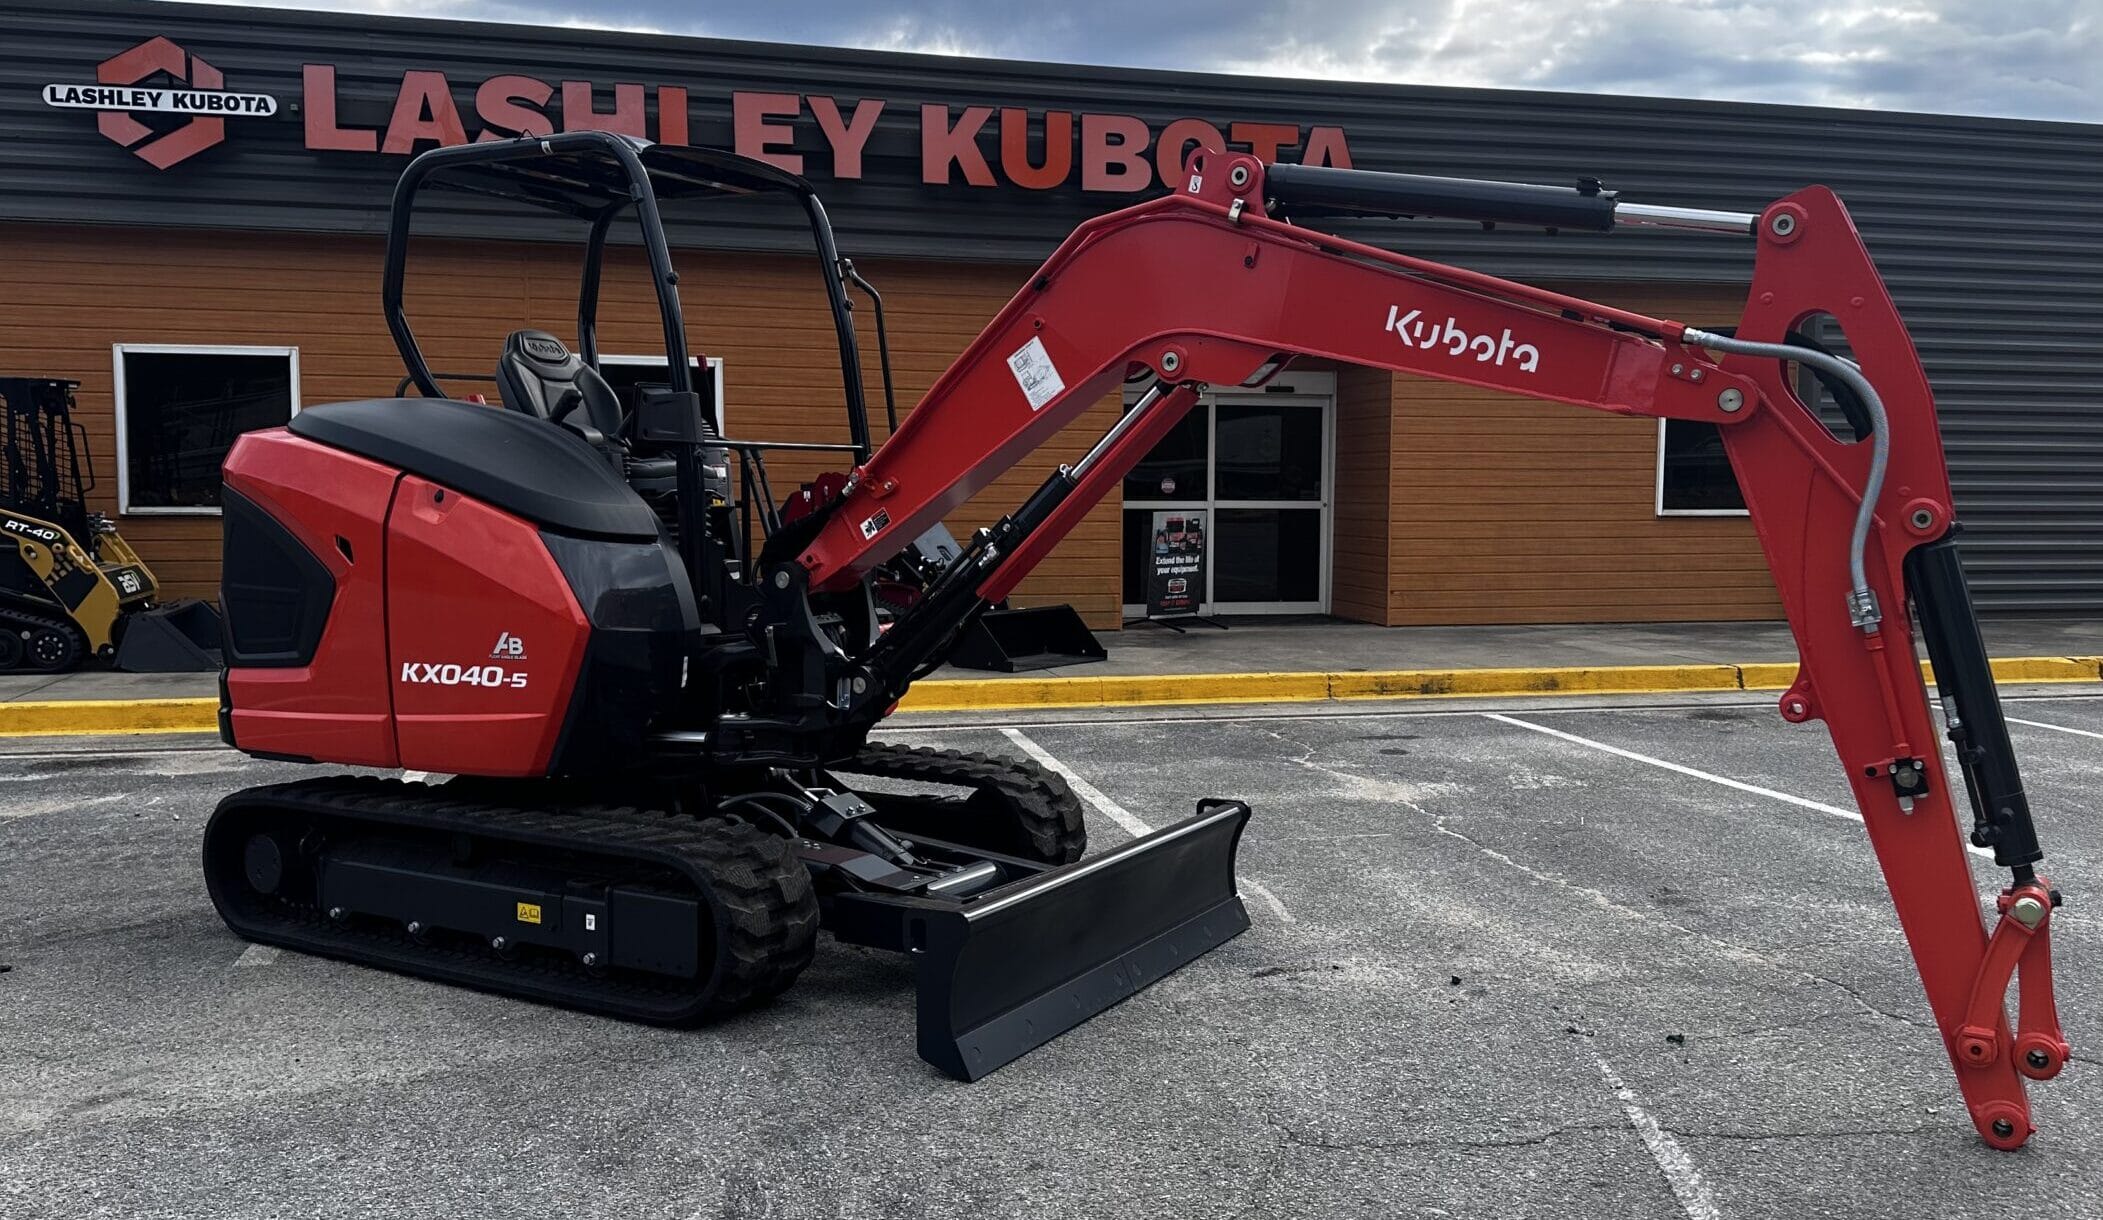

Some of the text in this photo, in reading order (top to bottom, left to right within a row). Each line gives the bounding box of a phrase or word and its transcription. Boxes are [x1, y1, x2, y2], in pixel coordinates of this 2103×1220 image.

[49, 86, 272, 113] LASHLEY KUBOTA
[1385, 304, 1540, 373] Kubota
[5, 520, 55, 540] RT-40
[1157, 567, 1170, 575] your
[1176, 556, 1185, 564] the
[401, 662, 528, 688] KX040-5
